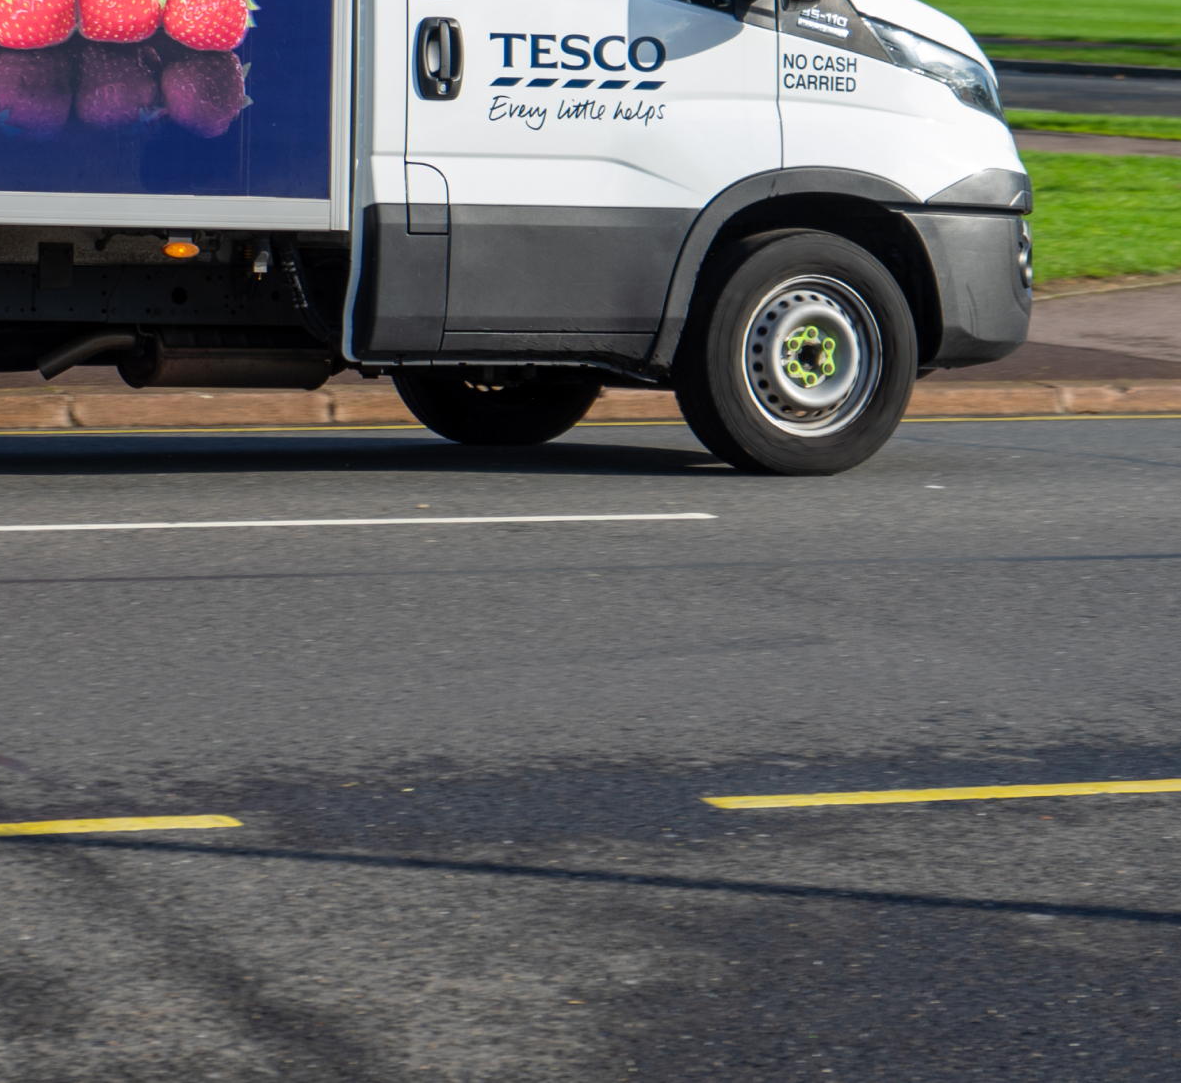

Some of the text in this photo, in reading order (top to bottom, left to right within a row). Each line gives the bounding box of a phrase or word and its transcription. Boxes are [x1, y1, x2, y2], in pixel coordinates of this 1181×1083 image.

[489, 32, 667, 73] TESCO
[783, 53, 857, 73] NO CASH
[783, 73, 857, 93] CARRIED
[489, 95, 667, 130] Every little helps
